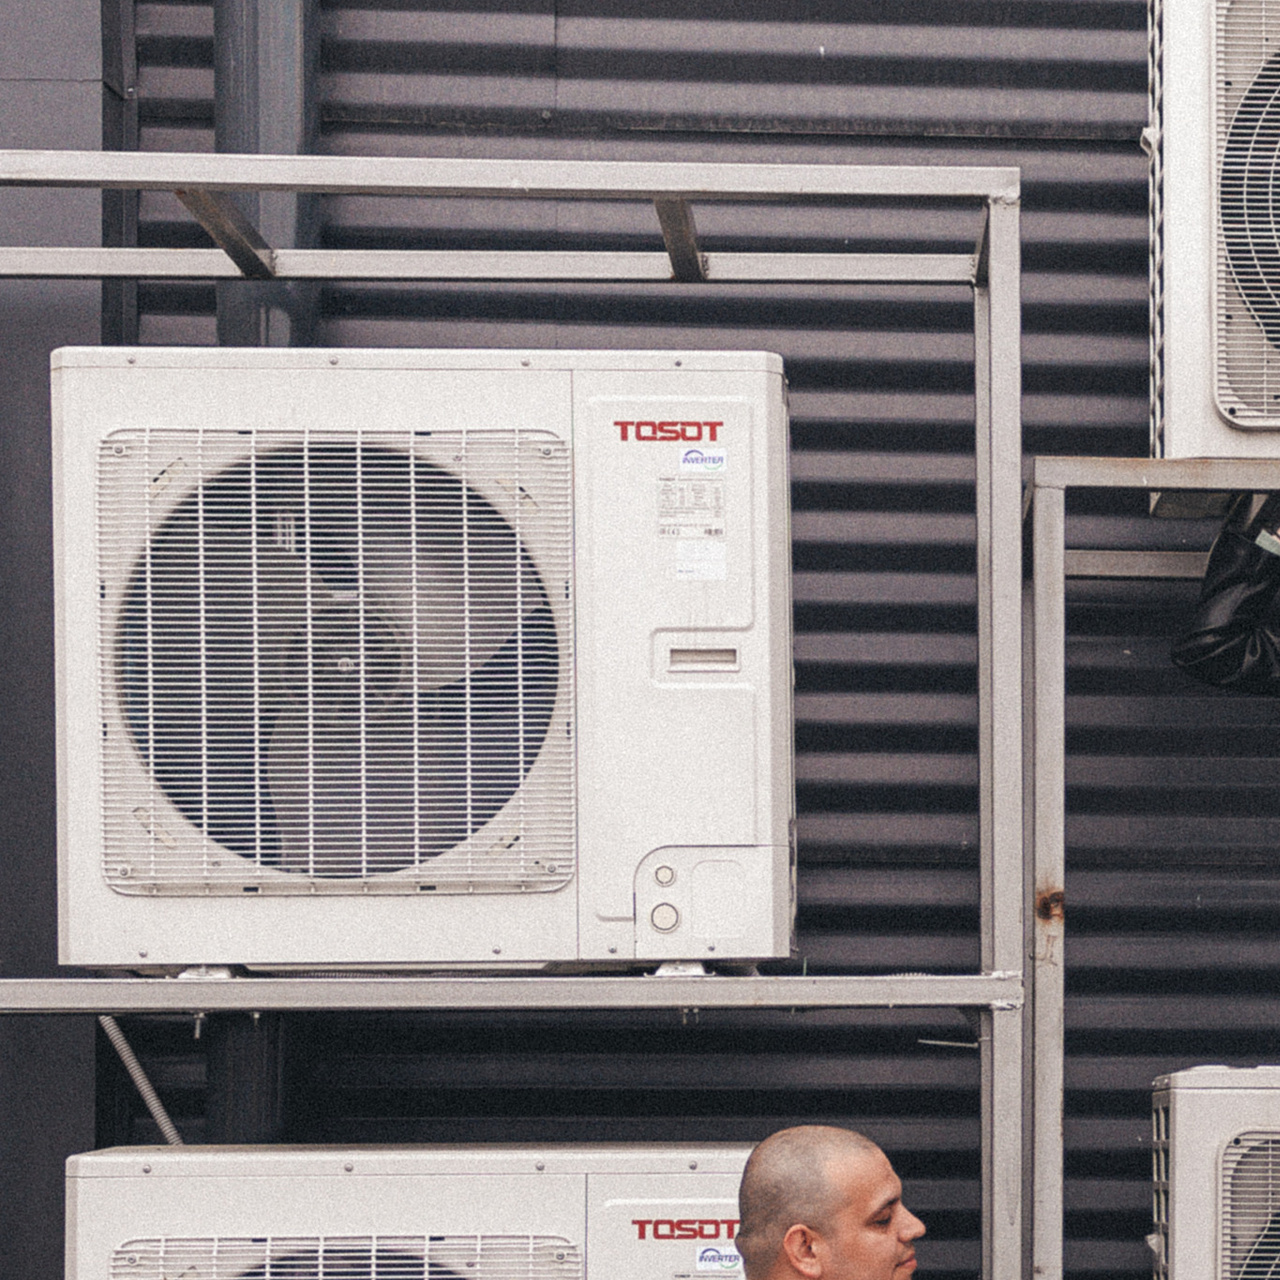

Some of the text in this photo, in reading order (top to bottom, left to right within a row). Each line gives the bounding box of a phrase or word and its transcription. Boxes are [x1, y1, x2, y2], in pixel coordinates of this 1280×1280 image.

[613, 420, 724, 441] TOSOT
[631, 1219, 741, 1240] TOSOT
[698, 1254, 740, 1263] INVERTER
